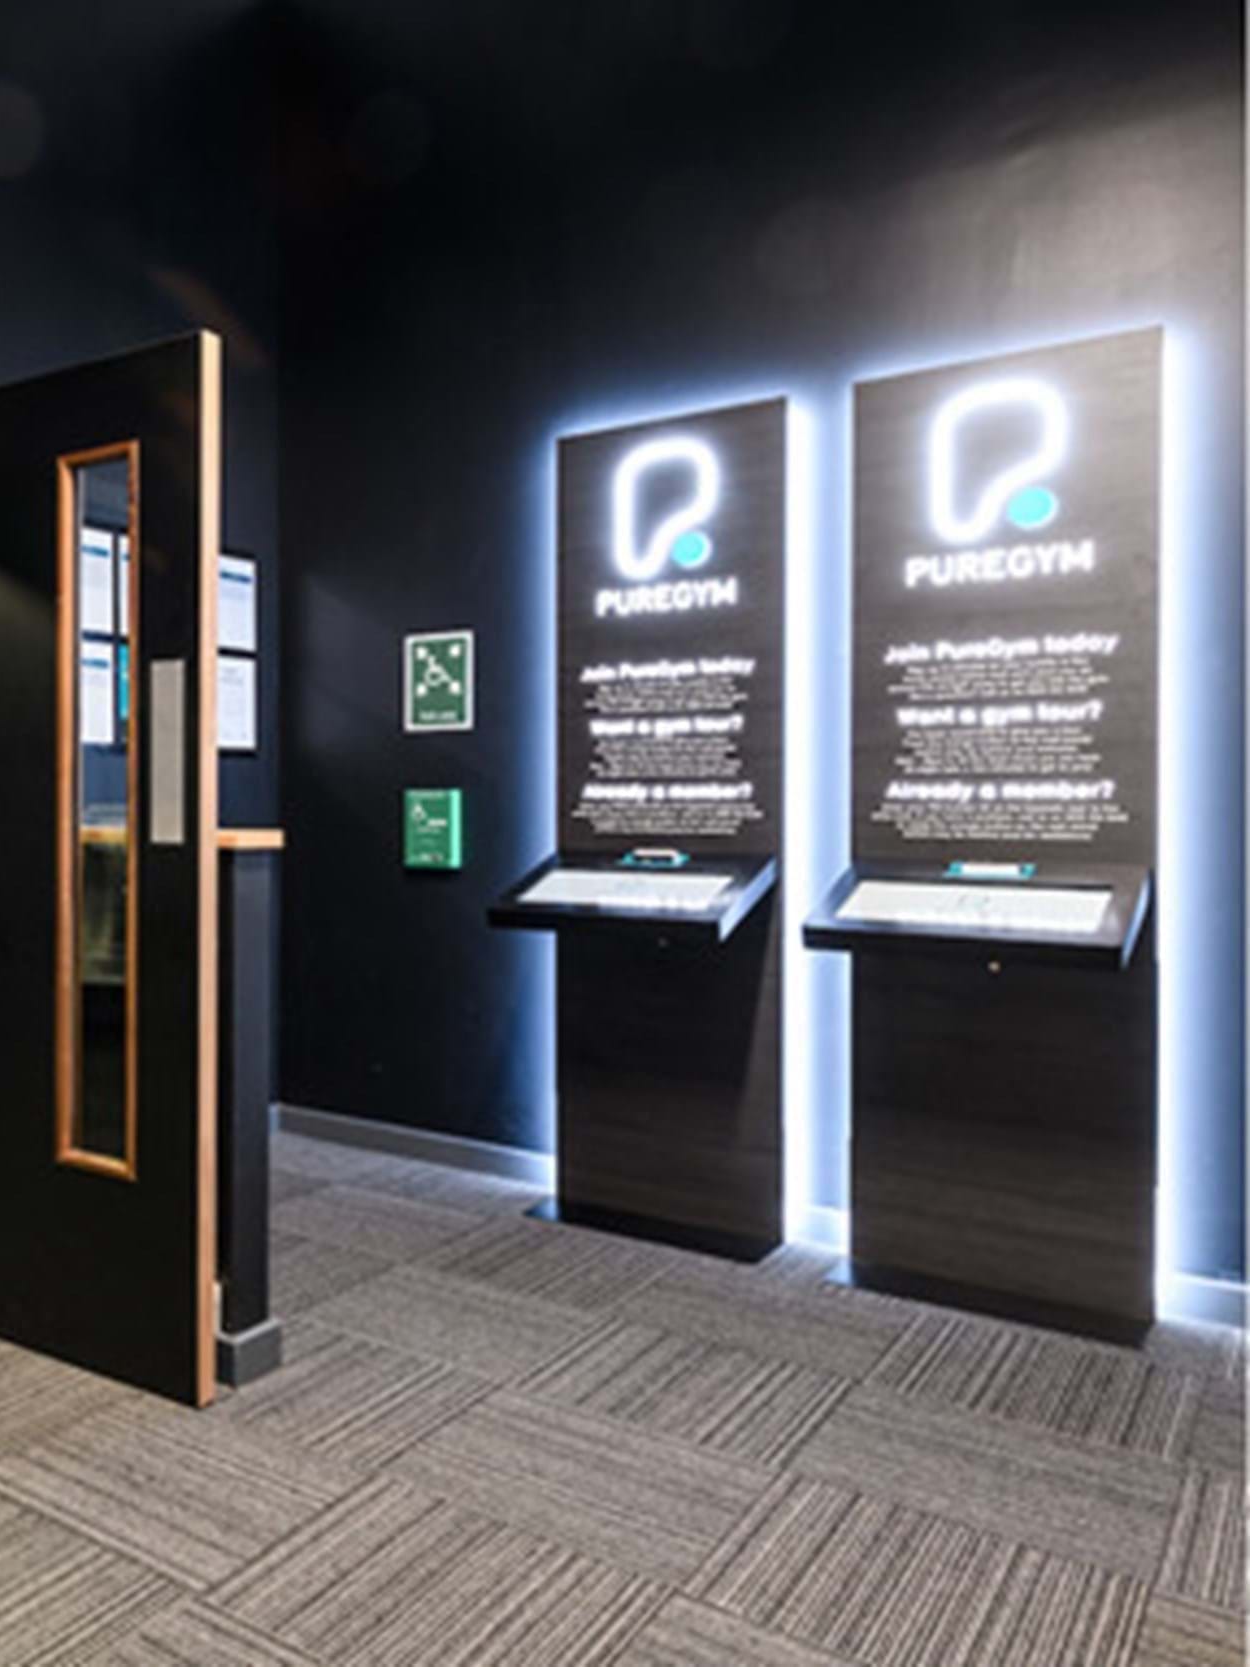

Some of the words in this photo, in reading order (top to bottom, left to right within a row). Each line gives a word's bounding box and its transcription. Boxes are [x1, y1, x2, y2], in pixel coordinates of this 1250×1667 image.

[905, 539, 1095, 588] PUREGYM
[596, 576, 738, 617] PUREGYM
[883, 642, 931, 665] Join
[934, 635, 1039, 661] PureGym
[1043, 631, 1121, 655] today
[896, 704, 955, 726] Want
[957, 706, 977, 725] a
[980, 704, 1034, 727] gym
[1036, 698, 1103, 722] tour?
[885, 779, 975, 804] Already
[978, 782, 997, 800] a
[1001, 778, 1116, 800] member?
